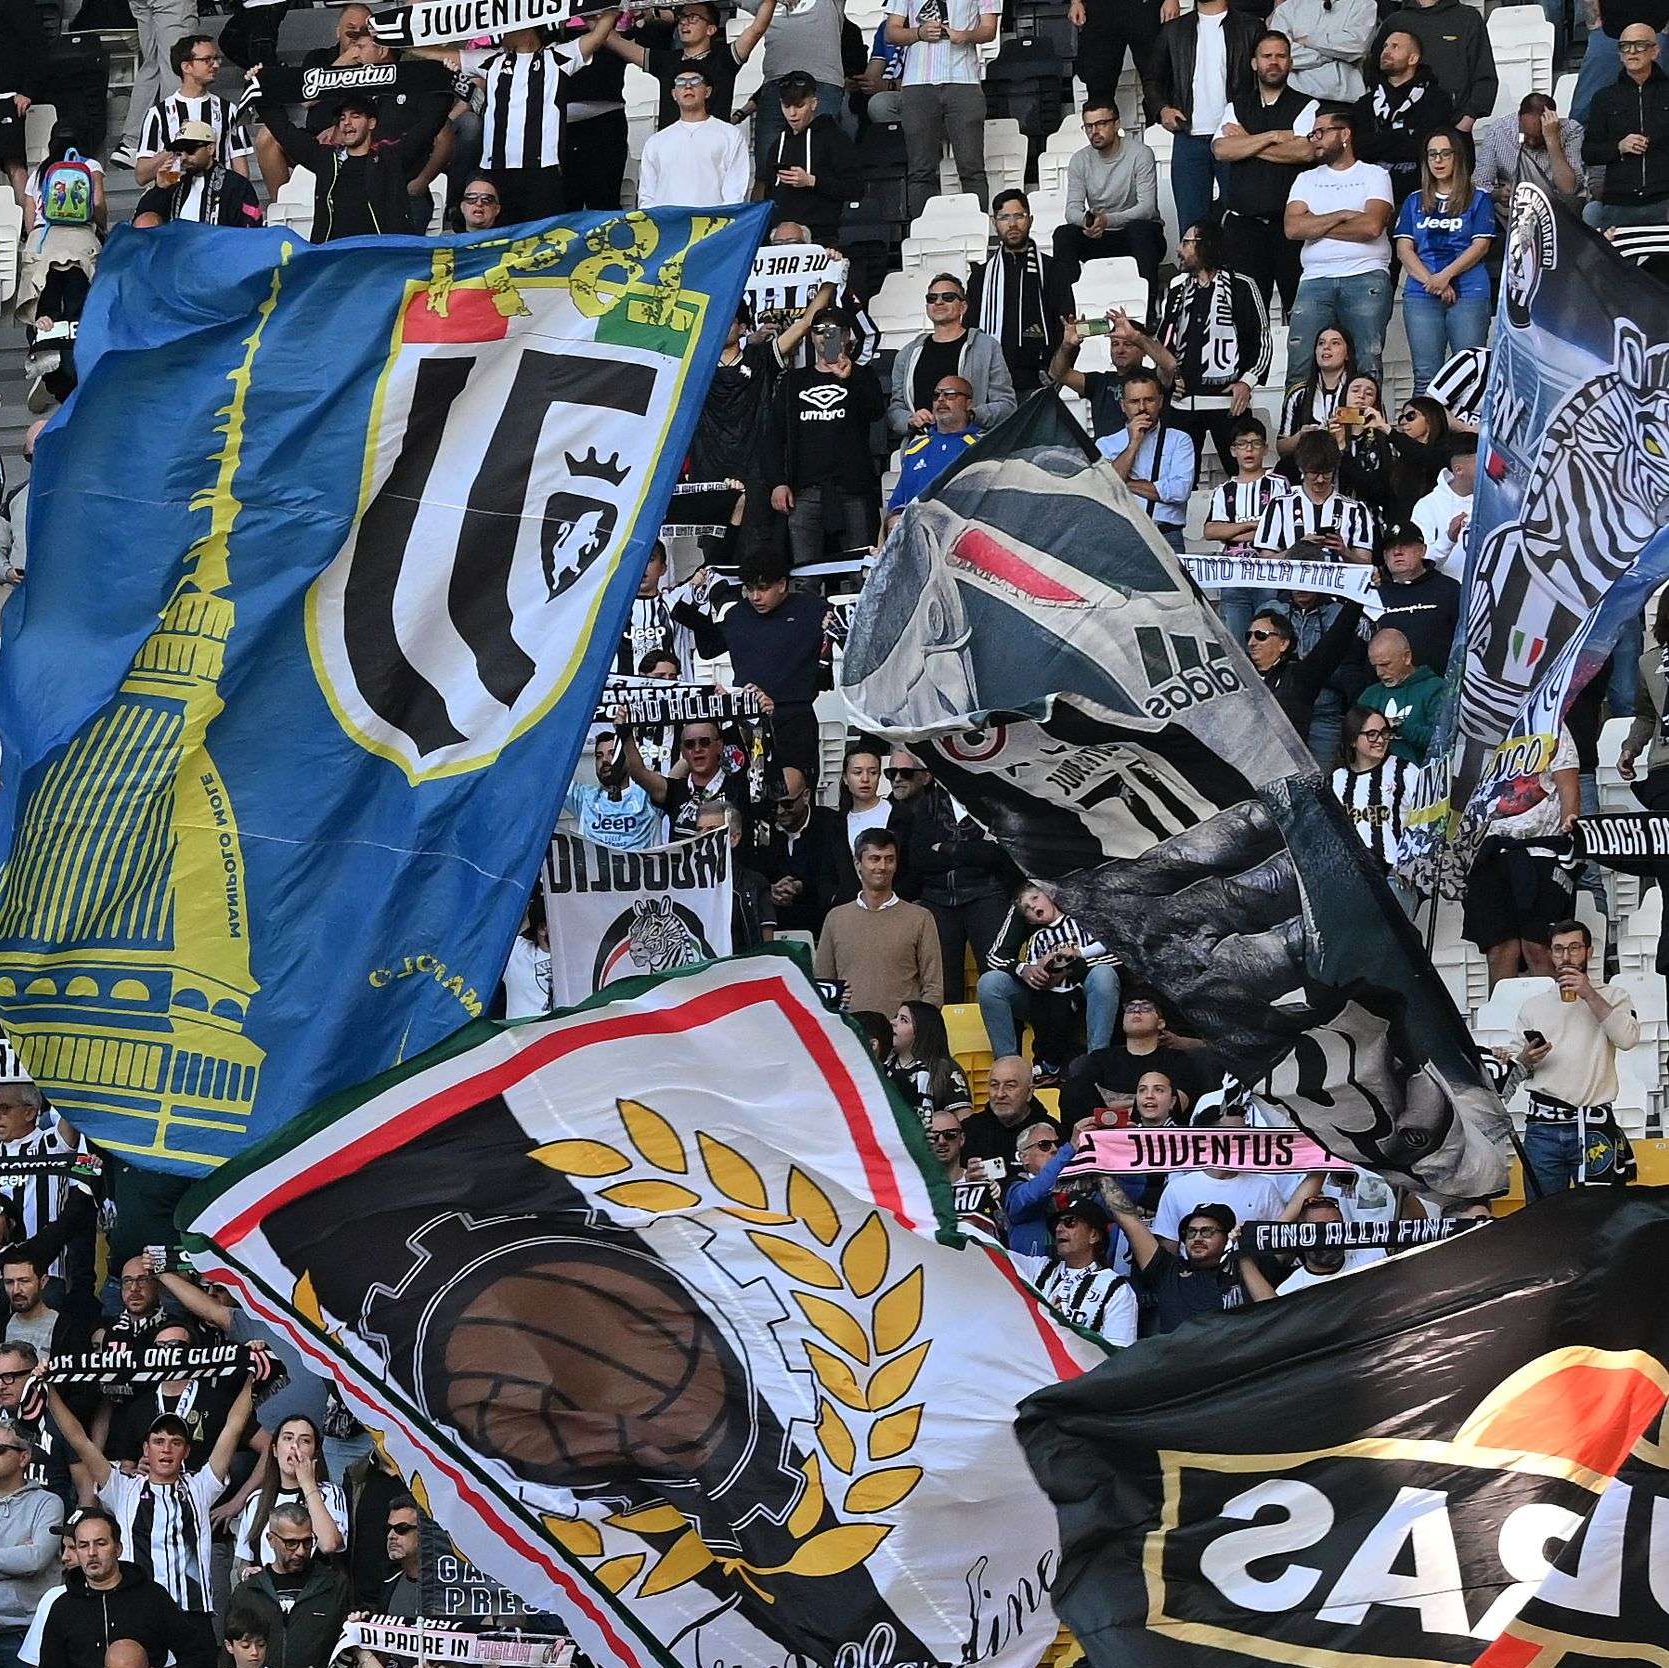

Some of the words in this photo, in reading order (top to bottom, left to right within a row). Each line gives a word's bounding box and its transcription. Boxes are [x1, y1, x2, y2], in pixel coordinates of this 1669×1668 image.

[422, 0, 557, 38] JUVENTUS
[304, 66, 397, 98] Juventus
[1417, 216, 1463, 231] Jeep
[800, 410, 845, 422] umbro
[1185, 559, 1235, 581] FINO
[1241, 560, 1299, 584] ALLA
[1303, 565, 1347, 588] FINE
[624, 625, 666, 643] Jeep
[670, 695, 723, 721] ALLA
[593, 814, 636, 833] Jeep
[1586, 819, 1647, 856] BLACK
[1129, 1135, 1294, 1167] JUVENTUS
[1255, 1225, 1319, 1250] FINO
[1325, 1222, 1391, 1247] ALLA
[1397, 1218, 1458, 1244] FINE
[145, 1347, 183, 1367] ONE
[188, 1343, 238, 1365] CLUB
[361, 1627, 378, 1648] DI
[383, 1630, 445, 1657] PADRE
[449, 1636, 470, 1657] IN
[475, 1639, 529, 1661] FIGLIA
